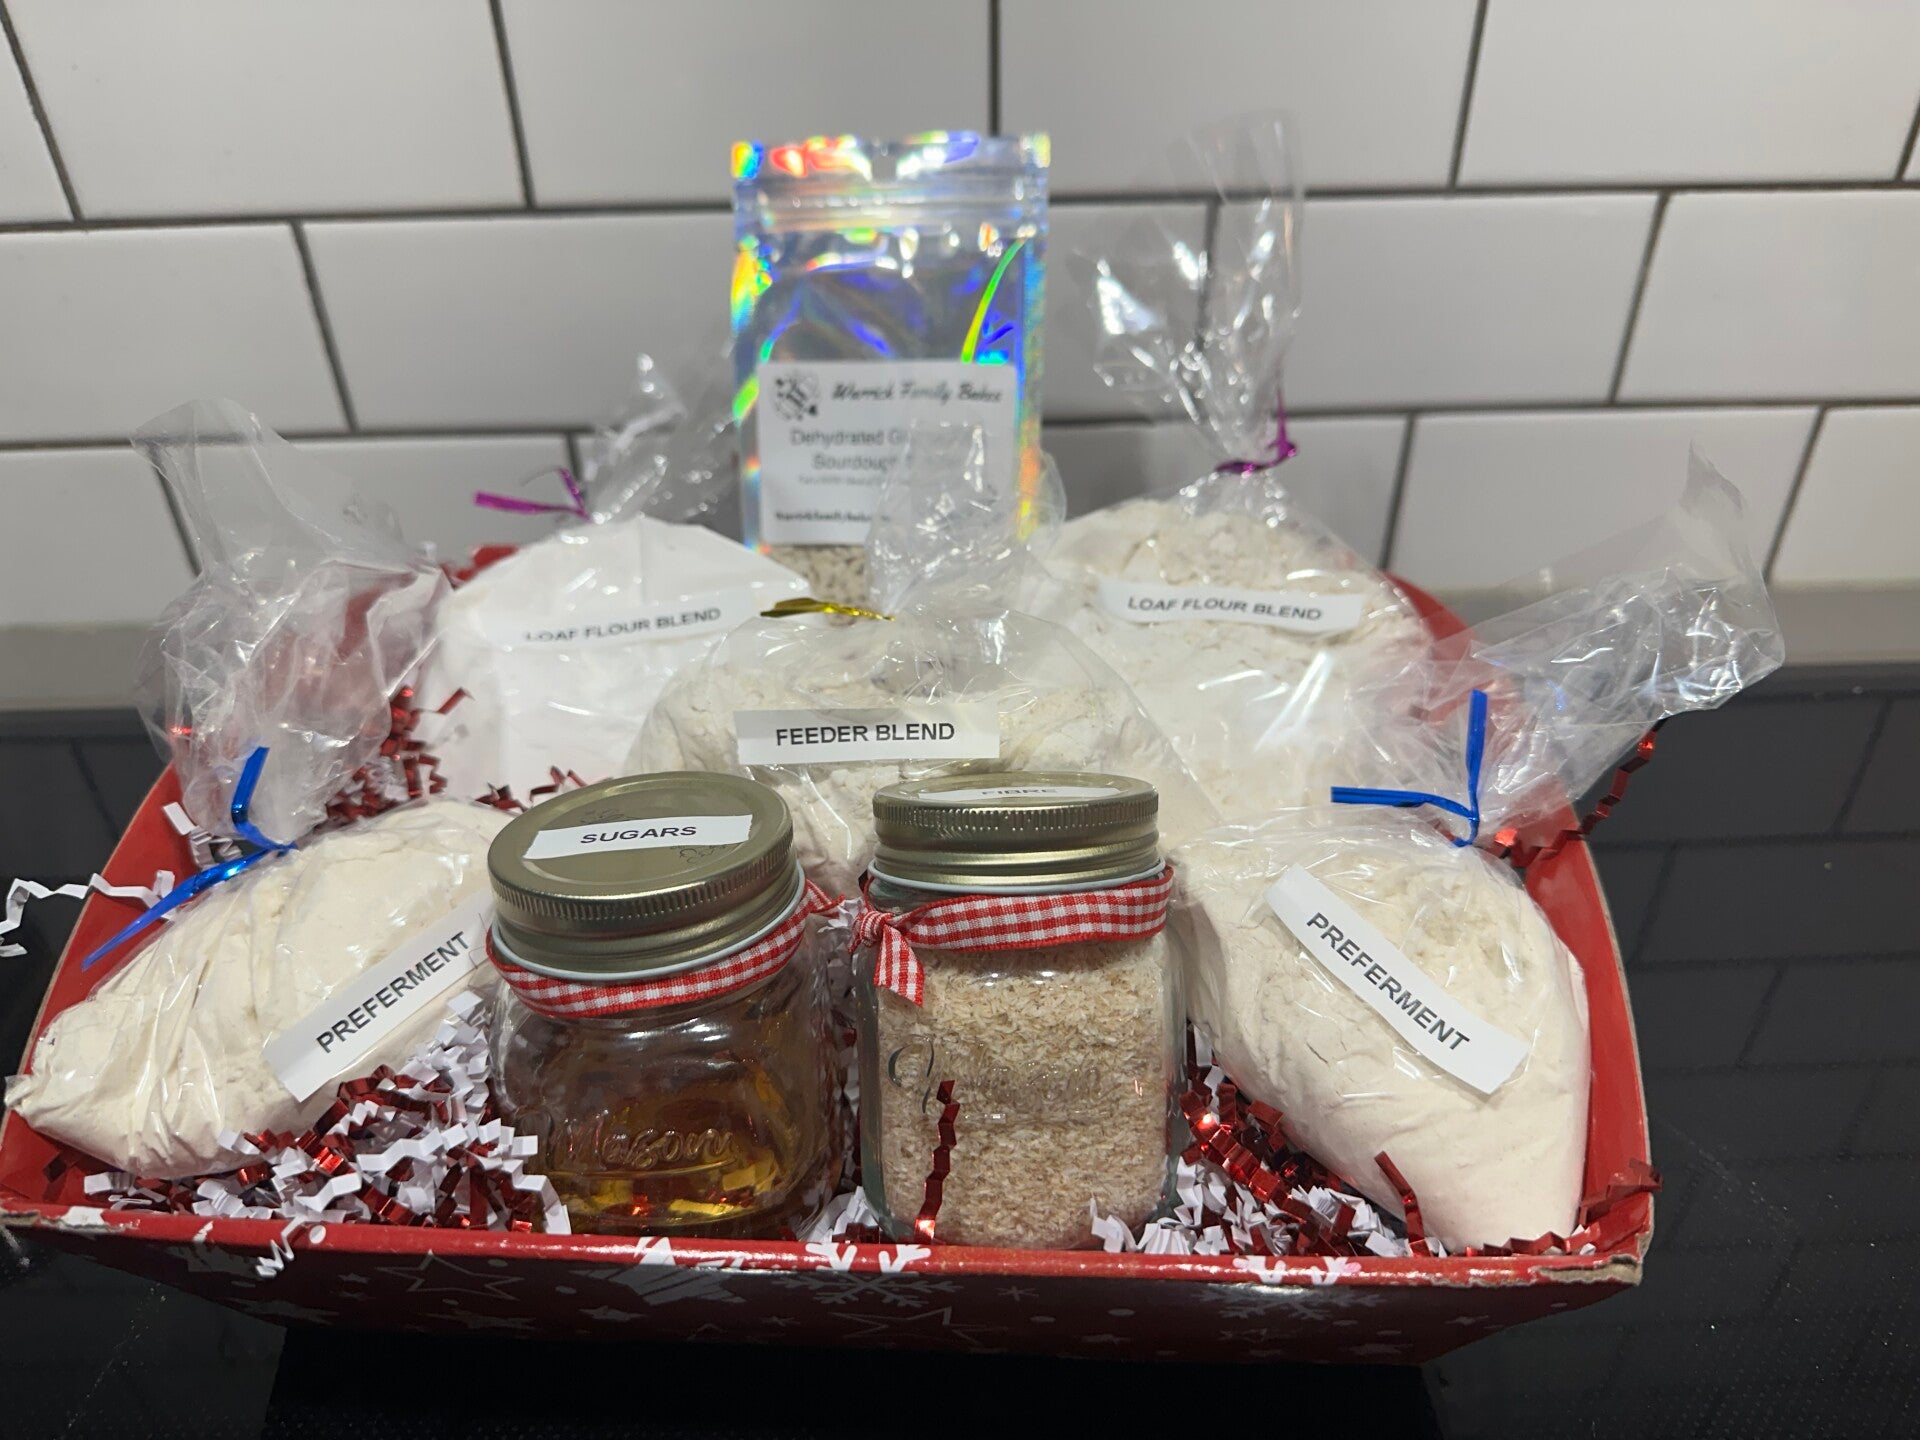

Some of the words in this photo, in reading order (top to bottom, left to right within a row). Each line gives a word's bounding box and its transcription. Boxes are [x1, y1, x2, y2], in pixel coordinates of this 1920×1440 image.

[790, 428, 884, 449] Dehydrated
[1127, 596, 1177, 612] LOAF
[1181, 597, 1247, 613] FLOUR
[1252, 603, 1322, 621] BLEND
[526, 630, 577, 642] LOAF
[584, 619, 650, 640] FLOUR
[656, 607, 721, 629] BLEND
[776, 725, 869, 746] FEEDER
[875, 722, 955, 741] BLEND
[580, 826, 697, 844] SUGARS
[316, 931, 469, 1053] PREFERMENT
[1306, 912, 1470, 1050] PREFERMENT
